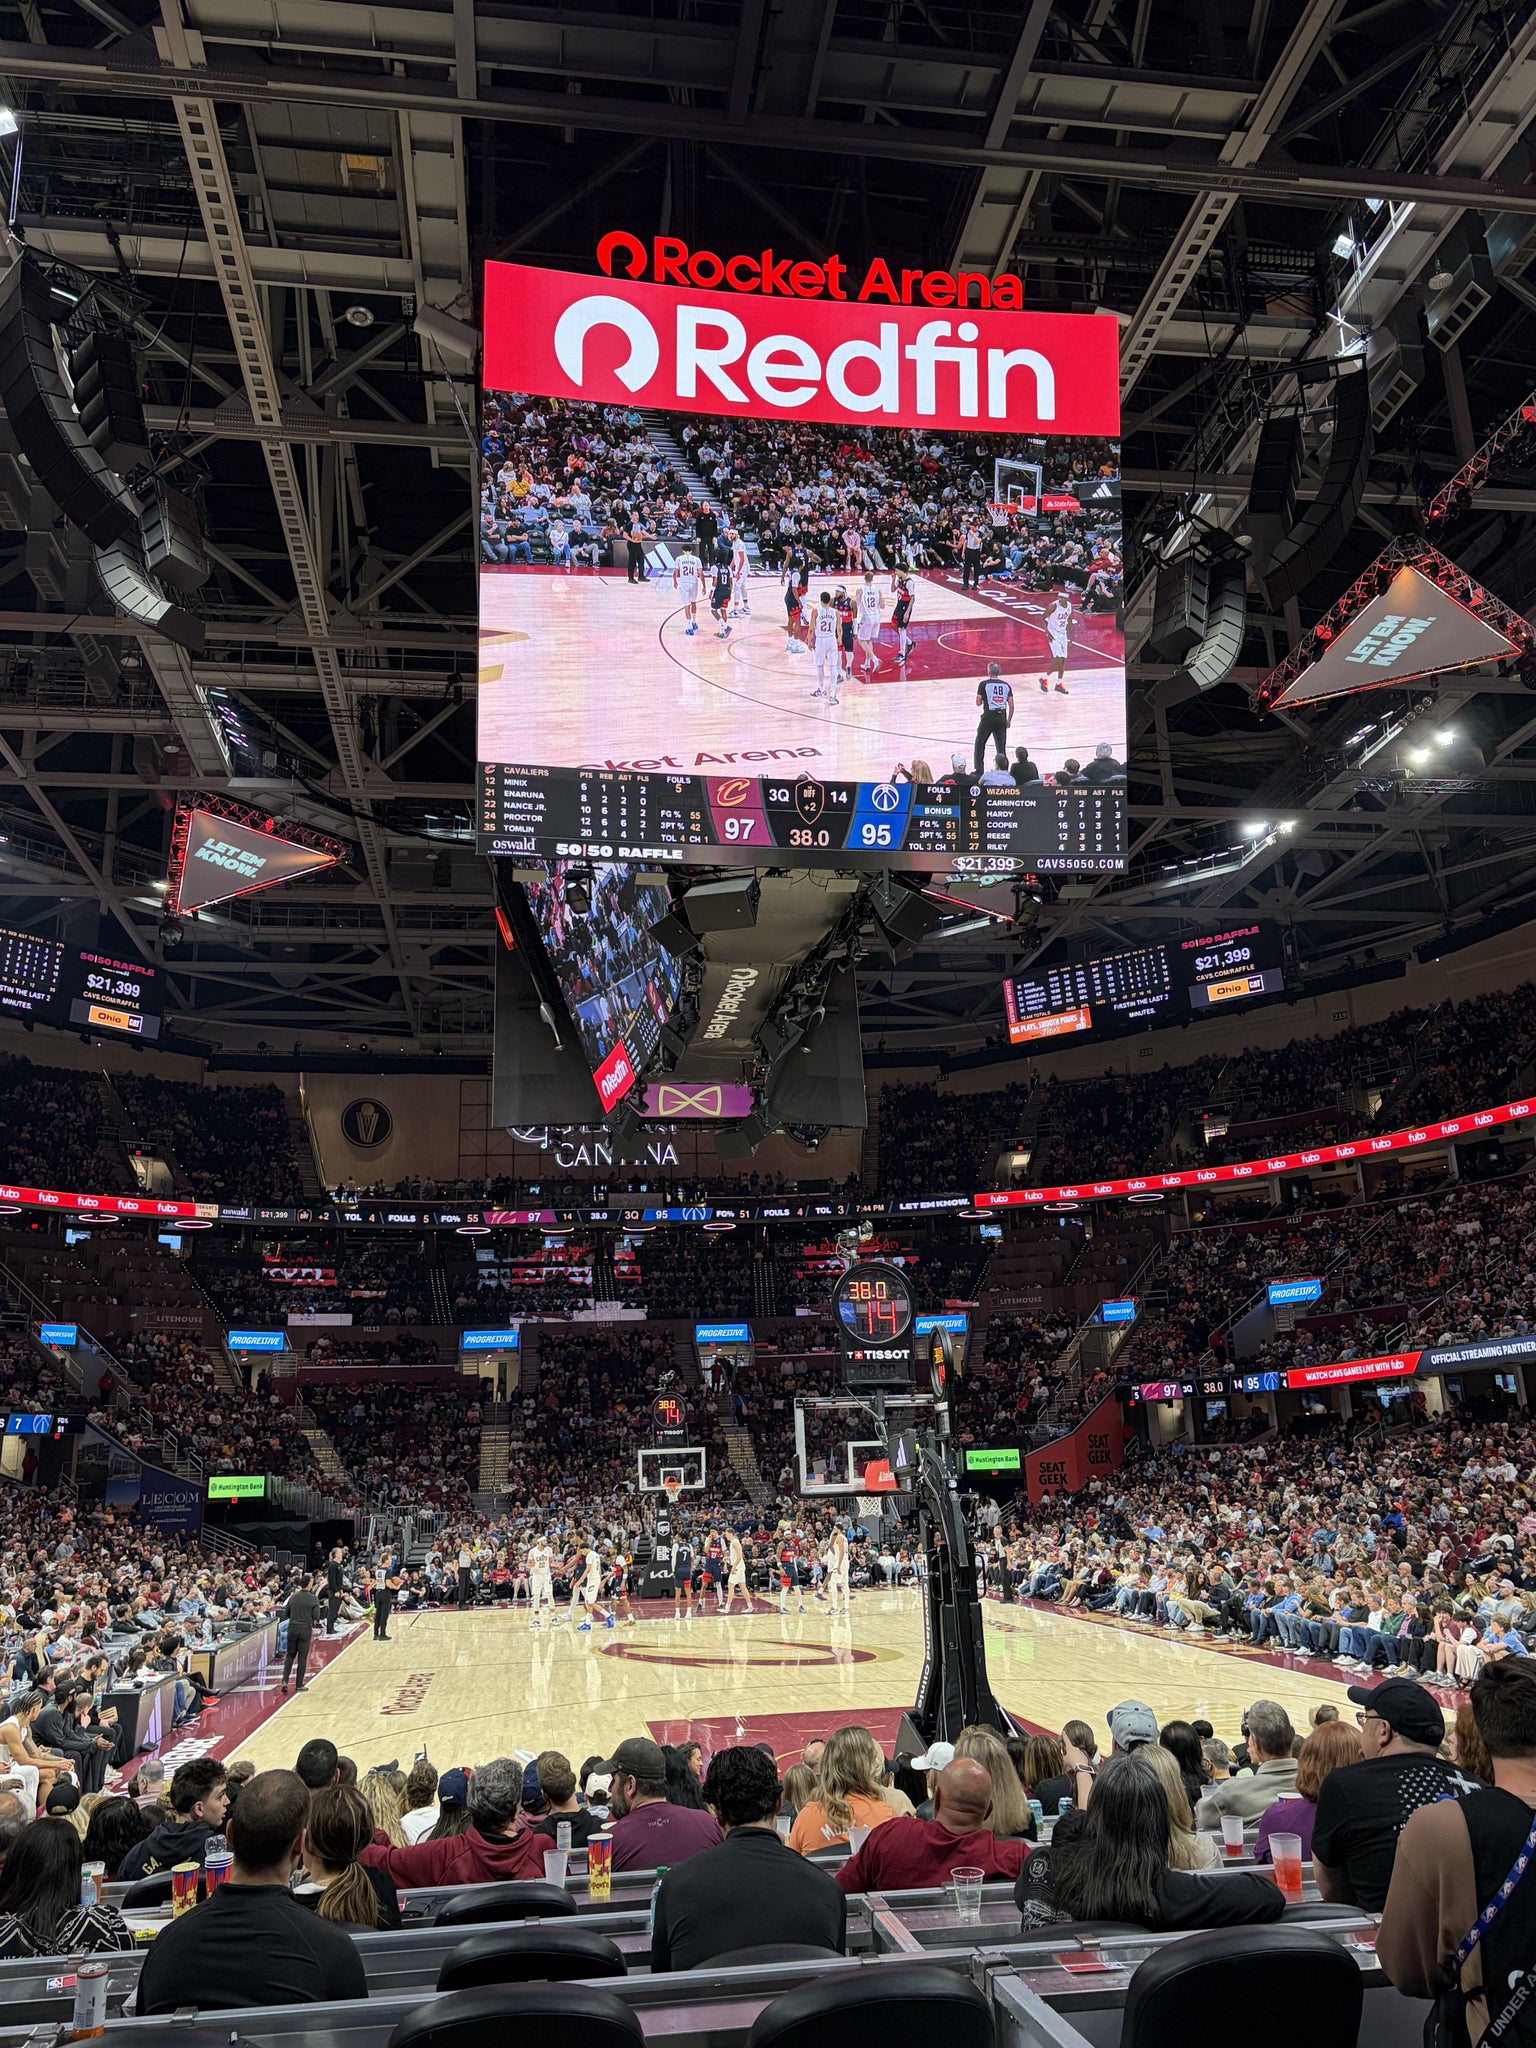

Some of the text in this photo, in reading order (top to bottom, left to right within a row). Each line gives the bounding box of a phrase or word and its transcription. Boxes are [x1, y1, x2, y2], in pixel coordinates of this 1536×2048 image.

[653, 236, 1023, 310] Rocket Arena
[675, 304, 1056, 421] Redfin
[1345, 614, 1408, 663] LET EM
[1368, 616, 1437, 667] KNOW.
[693, 743, 823, 767] Arena
[503, 766, 549, 777] CAVALIERS
[484, 777, 527, 787] 12 MINIX
[666, 776, 691, 784] FOULS
[484, 788, 544, 799] 21 ENARUNA
[675, 784, 682, 793] 5
[927, 786, 951, 794] FOULS
[986, 788, 1021, 796] WIZARDS
[768, 789, 790, 803] 3Q
[830, 790, 847, 804] 14
[935, 794, 942, 803] 4
[484, 800, 591, 814] 22 NANCE JR. 10
[803, 802, 816, 812] +2
[986, 800, 1067, 808] CARRINGTON 17
[660, 810, 701, 820] FG 55
[924, 807, 952, 815] BONUS
[484, 812, 591, 825] 24 PROCTOR 12
[483, 823, 496, 831] 35
[503, 825, 534, 833] TOMLIN
[660, 822, 701, 832] 3PT 42
[724, 817, 755, 841] 97
[919, 820, 956, 829] FG 51
[986, 821, 1018, 829] COOPER
[661, 834, 701, 843] TOL CH
[789, 829, 830, 847] 38.0
[861, 823, 891, 846] 95
[946, 832, 957, 840] 55
[986, 832, 1011, 840] REESE
[492, 837, 536, 851] oswald
[908, 843, 946, 851] TOL CH
[986, 843, 1008, 851] RILEY
[204, 837, 267, 868] LET EM
[618, 847, 683, 860] RAFFLE
[194, 847, 261, 879] KNOW.
[957, 857, 1124, 872] $21,399 CAVS5050.COM
[1214, 925, 1260, 943] RAFFLE
[1195, 947, 1251, 972] $21,399
[112, 960, 155, 977] RAFFLE
[86, 973, 141, 998] $21,399
[1249, 979, 1261, 988] CAT
[15, 988, 45, 1000] THE LAST
[1216, 985, 1242, 995] Ohio
[1136, 994, 1164, 1006] THE LAST
[703, 980, 756, 1039] Rocket Arena
[97, 1012, 121, 1023] Ohio
[128, 1018, 140, 1028] CAT
[1509, 1104, 1529, 1116] fubo
[1441, 1123, 1459, 1134] fubo
[1372, 1138, 1391, 1150] fubo
[555, 1142, 679, 1168] CANNA
[1301, 1153, 1320, 1164] fubo
[1233, 1165, 1252, 1175] fubo
[1162, 1175, 1181, 1185] fubo
[1093, 1184, 1112, 1194] fubo
[1024, 1191, 1043, 1201] fubo
[77, 1196, 178, 1214] fubo fubo
[739, 1210, 750, 1219] 51
[763, 1208, 790, 1216] FOULS
[815, 1206, 831, 1214] TOL
[855, 1204, 872, 1212] 7:44
[899, 1202, 919, 1210] LET
[920, 1201, 935, 1209] EM
[936, 1198, 970, 1208] KNOW.
[222, 1207, 249, 1217] oswald
[527, 1210, 669, 1222] 97 3Q 95
[344, 1213, 480, 1223] TOL FOULS 55
[848, 1281, 886, 1300] 38.0
[1270, 1285, 1318, 1299] PROGRESSIVE
[1000, 1295, 1042, 1305] LITEHOUSE
[156, 1314, 203, 1324] LITEHOUSE
[866, 1301, 896, 1336] 14
[697, 1328, 745, 1337] PROGRESSIVE
[230, 1335, 280, 1346] PROGRESSIVE
[465, 1335, 515, 1344] PROGRESSIVE
[864, 1350, 910, 1360] TISSOT
[1430, 1341, 1536, 1365] OFFICIAL STREAMING PARTNER
[1305, 1361, 1391, 1381] WATCH CAVS GAMES LIVE WITH
[1163, 1377, 1260, 1397] 97 38.0 14 95
[658, 1400, 676, 1409] 38.0
[15, 1418, 22, 1430] 7
[1088, 1433, 1109, 1449] SEAT
[975, 1454, 1019, 1465] Huntington Bank
[1088, 1448, 1112, 1465] GEEK
[1039, 1460, 1067, 1473] SEAT
[1038, 1472, 1068, 1486] GEEK
[218, 1482, 248, 1493] Huntington
[682, 1550, 688, 1561] 7
[917, 1584, 932, 1709] Cleveland Clinic
[1490, 1986, 1530, 2037] UNDER
